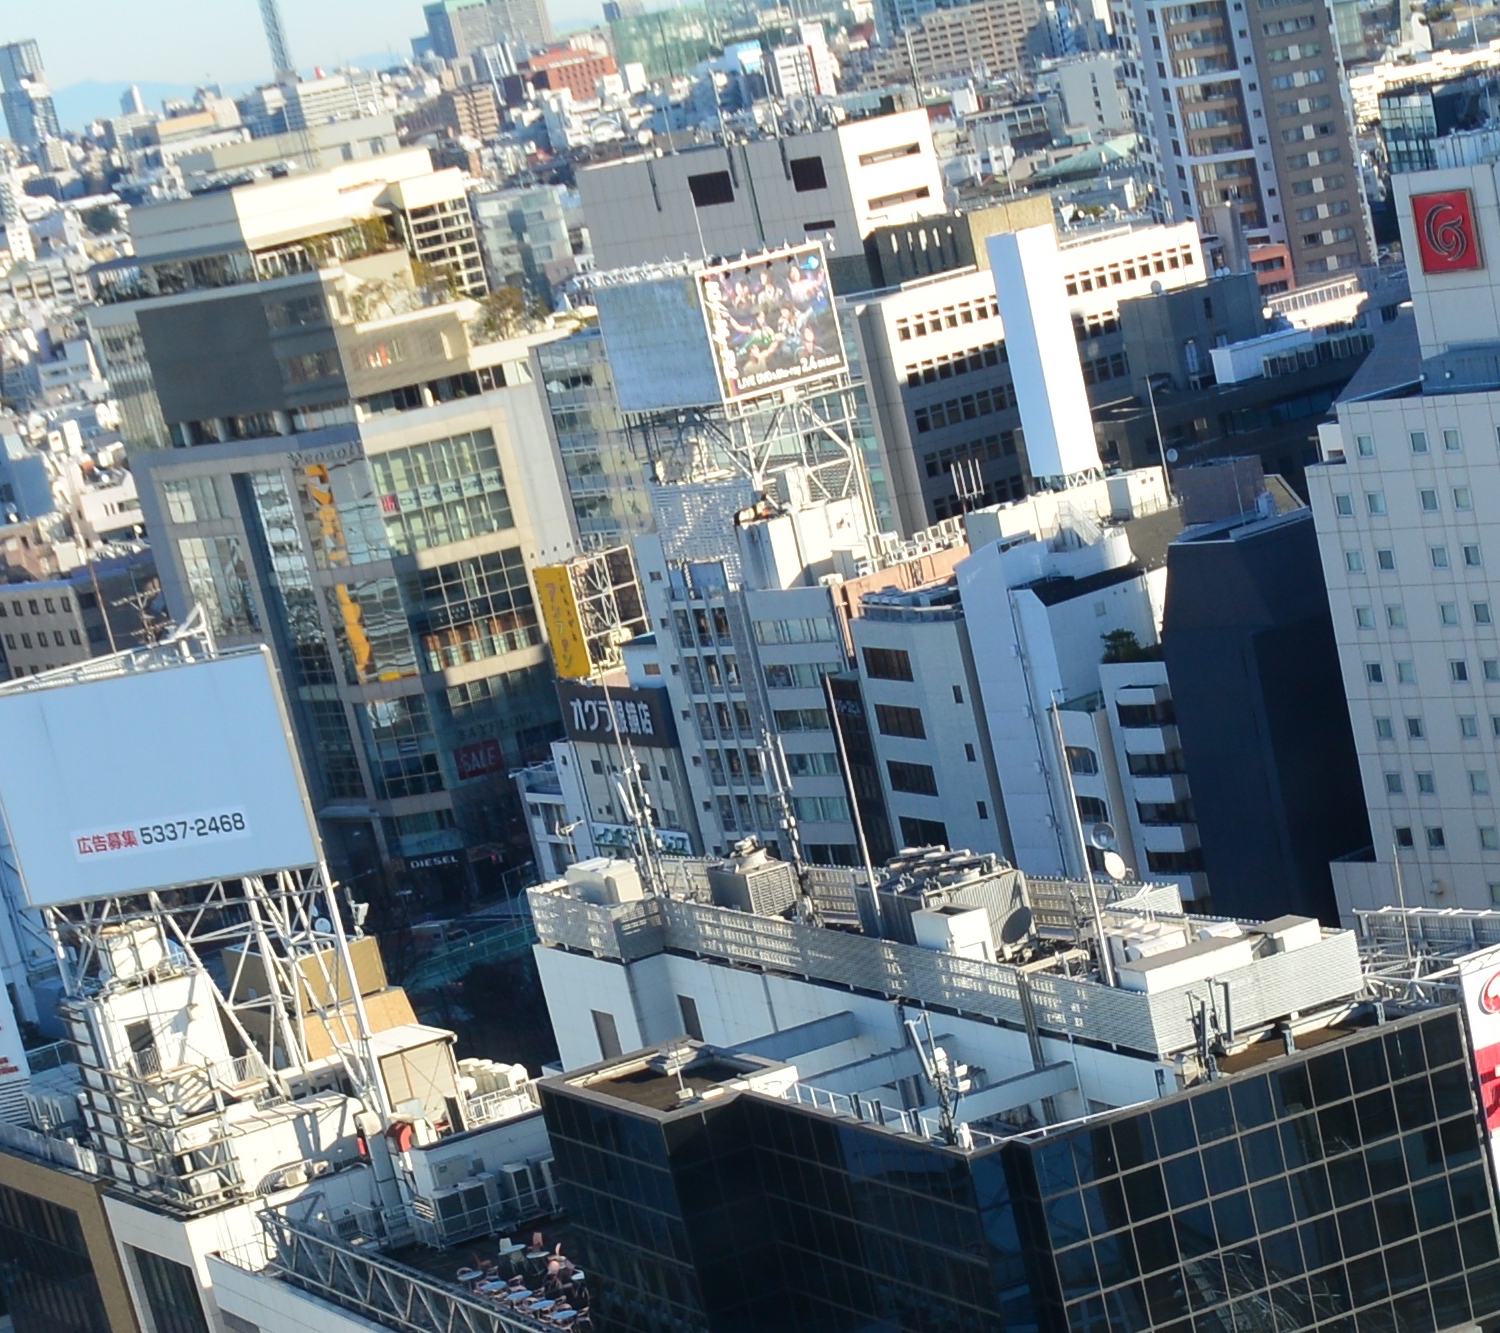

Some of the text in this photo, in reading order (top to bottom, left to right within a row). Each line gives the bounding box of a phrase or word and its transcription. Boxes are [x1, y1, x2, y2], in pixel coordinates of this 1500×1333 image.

[459, 744, 496, 774] SALE
[76, 811, 246, 856] 広告募集 5337-2468
[409, 853, 459, 869] DIESEL
